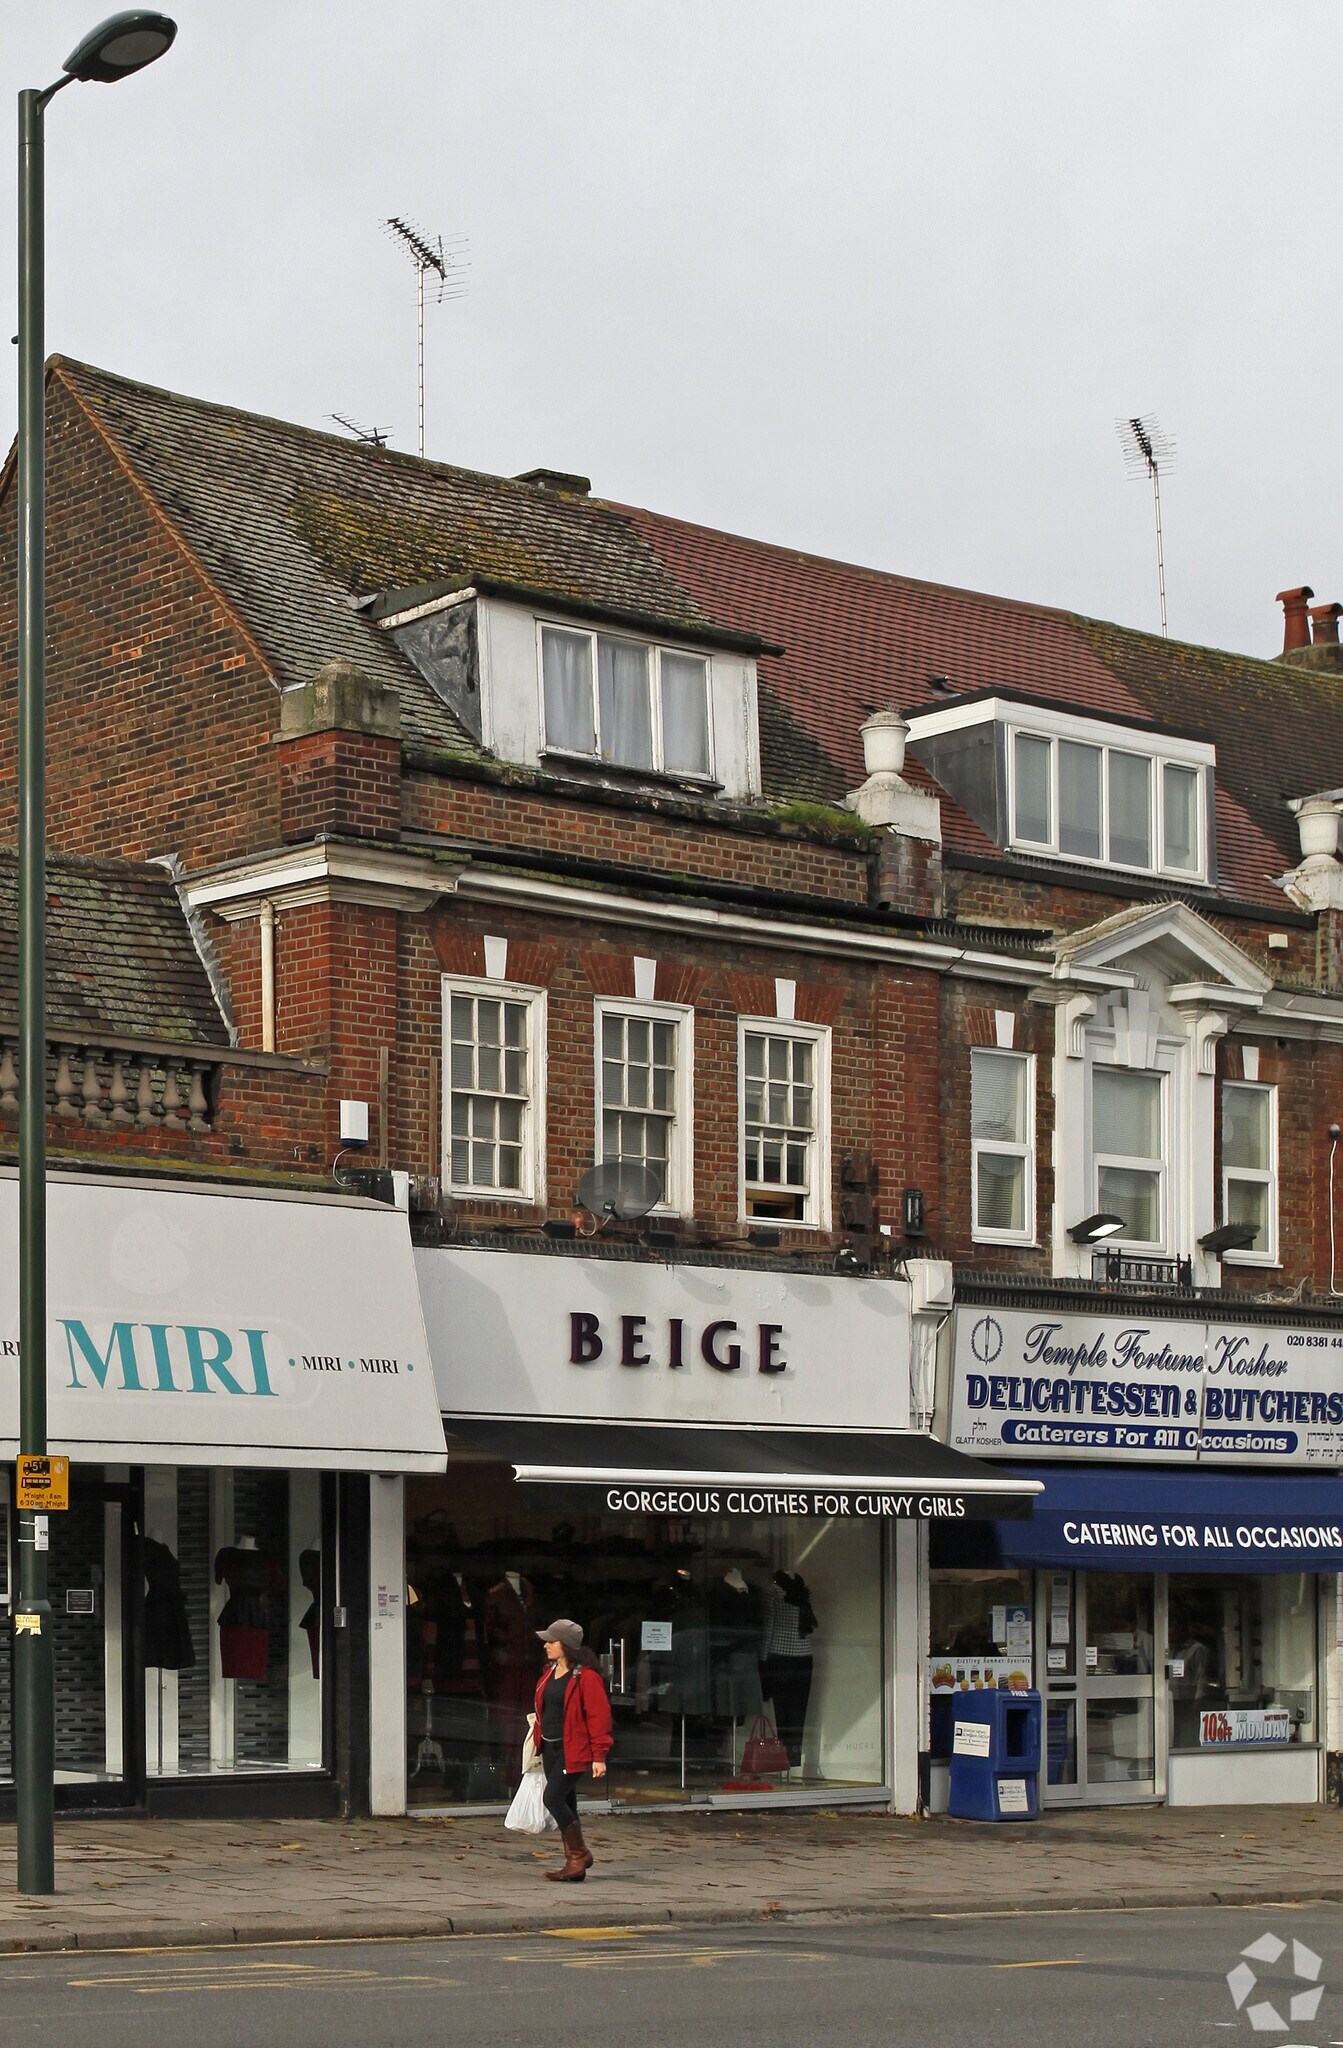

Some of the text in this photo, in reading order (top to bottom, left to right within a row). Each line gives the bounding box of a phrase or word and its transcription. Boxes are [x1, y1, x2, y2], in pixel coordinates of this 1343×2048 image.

[569, 1311, 787, 1373] BEIGE
[1023, 1323, 1289, 1377] Temple Fortune Kosher
[1287, 1335, 1304, 1347] 020
[1306, 1336, 1328, 1348] 8381
[56, 1318, 279, 1396] MIRI
[302, 1356, 400, 1374] MIRI MIRI
[966, 1374, 1343, 1425] DELICATESSEN & BUTCHERS
[956, 1436, 1002, 1446] GLATT KOSHER
[1014, 1423, 1108, 1445] Caterers
[1114, 1427, 1148, 1446] For
[1154, 1429, 1179, 1447] All
[606, 1489, 965, 1517] GORGEOUS CLOTHES FOR CURVY GIRLS
[1062, 1521, 1343, 1549] CATERING FOR ALL OCCASIONS
[1236, 1720, 1289, 1741] MONDAY
